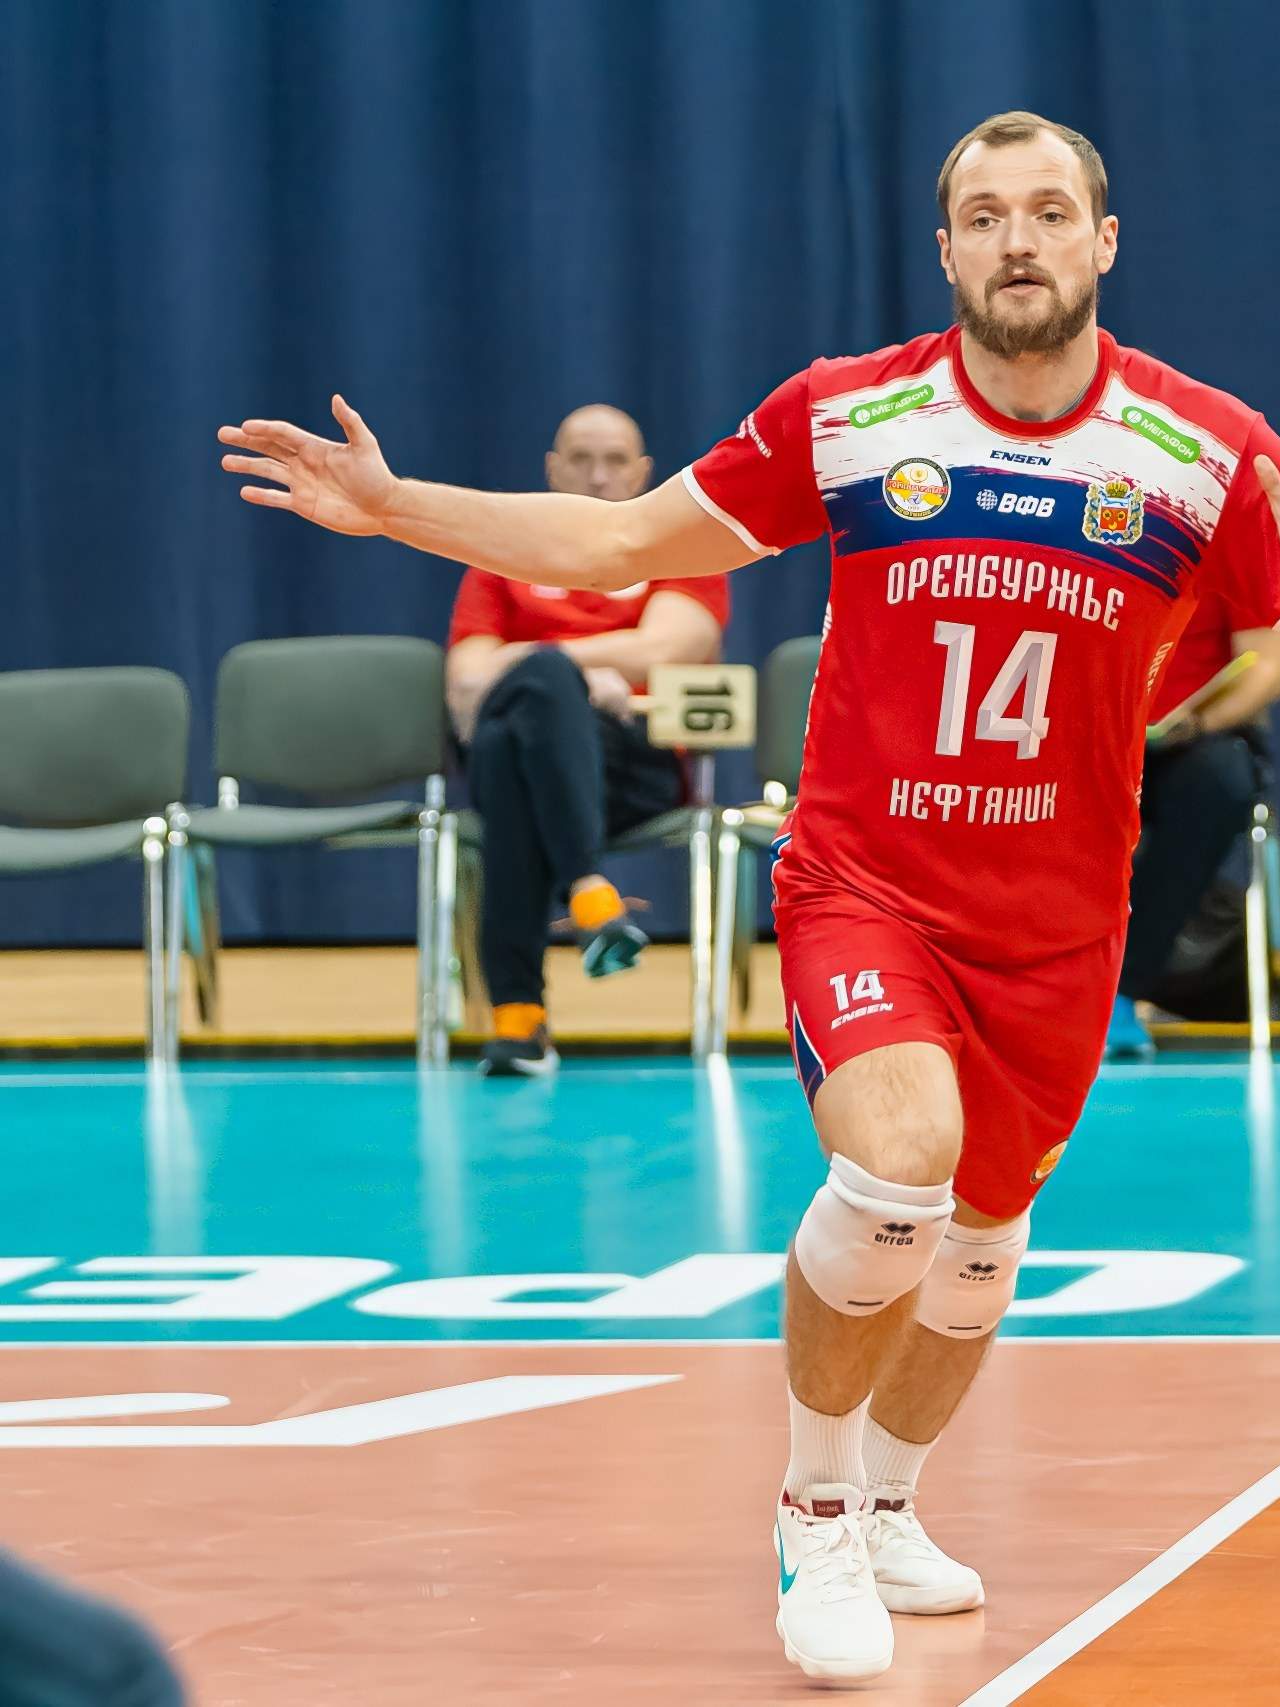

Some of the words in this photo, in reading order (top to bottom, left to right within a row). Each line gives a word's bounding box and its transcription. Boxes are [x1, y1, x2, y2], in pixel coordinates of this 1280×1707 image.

[989, 450, 1052, 466] ENSEN
[998, 492, 1056, 518] ВФВ
[886, 553, 1125, 632] ОРЕНБУРЖЬЕ
[684, 682, 733, 731] 16
[933, 619, 1059, 761] 14
[889, 777, 1058, 826] НЕФТЯНИК
[829, 969, 885, 1012] 14
